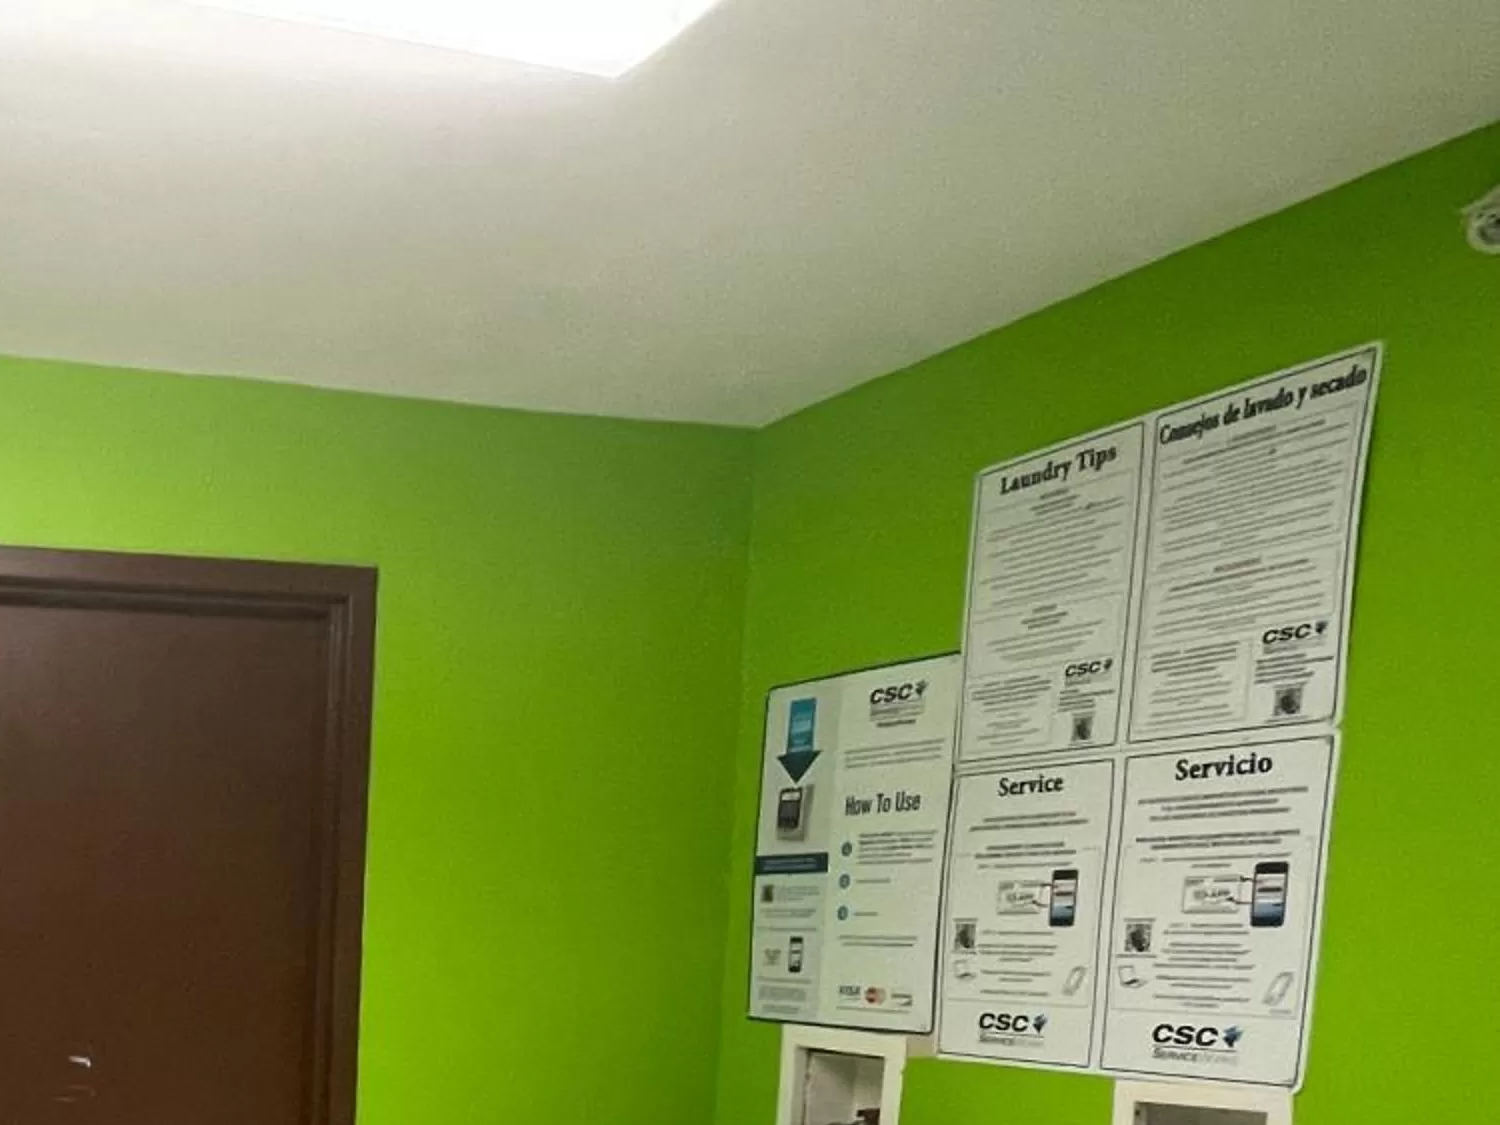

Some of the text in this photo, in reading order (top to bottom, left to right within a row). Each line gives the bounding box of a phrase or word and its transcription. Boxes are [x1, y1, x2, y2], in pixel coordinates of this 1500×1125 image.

[1160, 364, 1367, 445] Consejos de lavado y secado
[1000, 446, 1117, 495] Laundry Tips
[1263, 623, 1311, 645] CSC
[1065, 661, 1101, 677] CSC
[870, 683, 913, 705] CSC
[1175, 752, 1273, 781] Servicio
[998, 774, 1064, 797] Service
[845, 790, 921, 816] How To Use
[979, 1013, 1029, 1032] CSC
[1152, 1023, 1219, 1047] CSC
